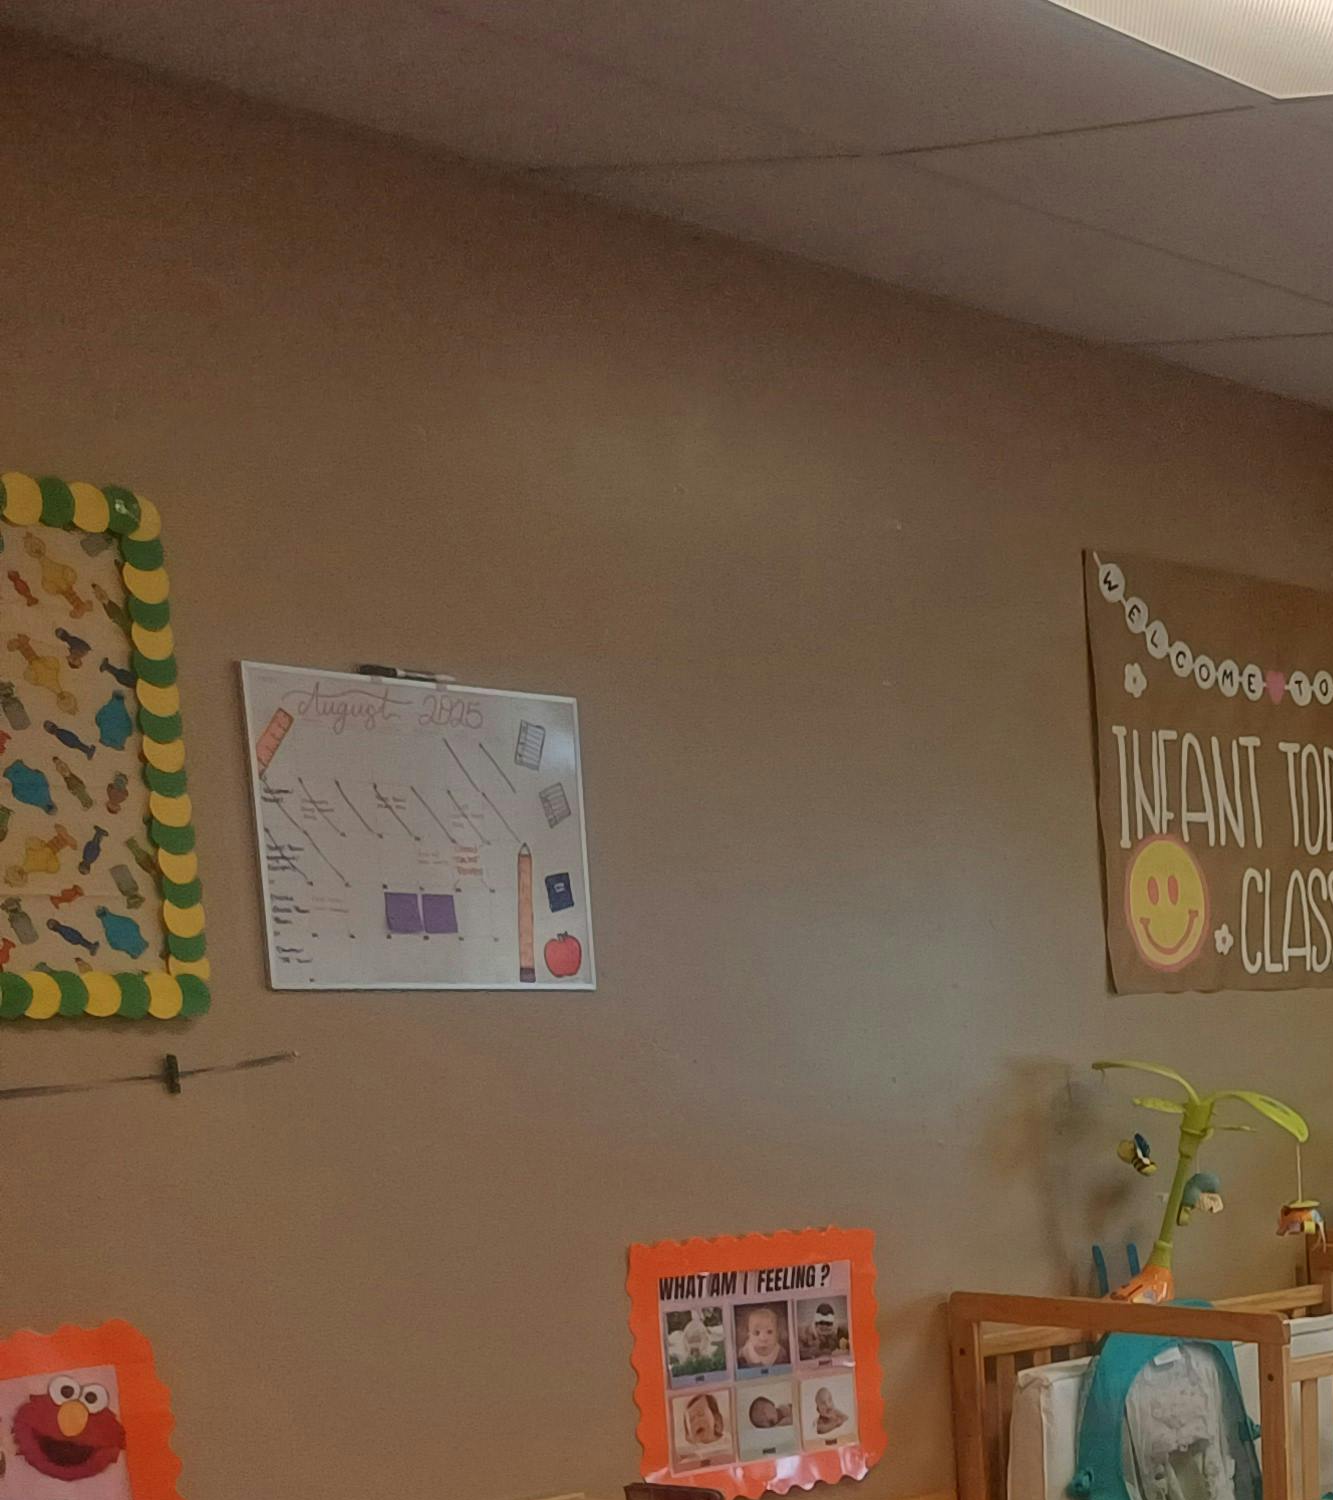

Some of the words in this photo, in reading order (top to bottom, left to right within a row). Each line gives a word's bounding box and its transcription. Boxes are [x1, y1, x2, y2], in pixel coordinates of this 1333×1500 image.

[1101, 567, 1260, 692] WELCOME
[1292, 674, 1332, 701] TO
[283, 682, 411, 735] August
[418, 695, 485, 730] 2025
[1111, 725, 1263, 849] INFANT
[659, 1274, 706, 1301] WHAT
[710, 1271, 737, 1297] AM
[757, 1264, 816, 1293] FEELING
